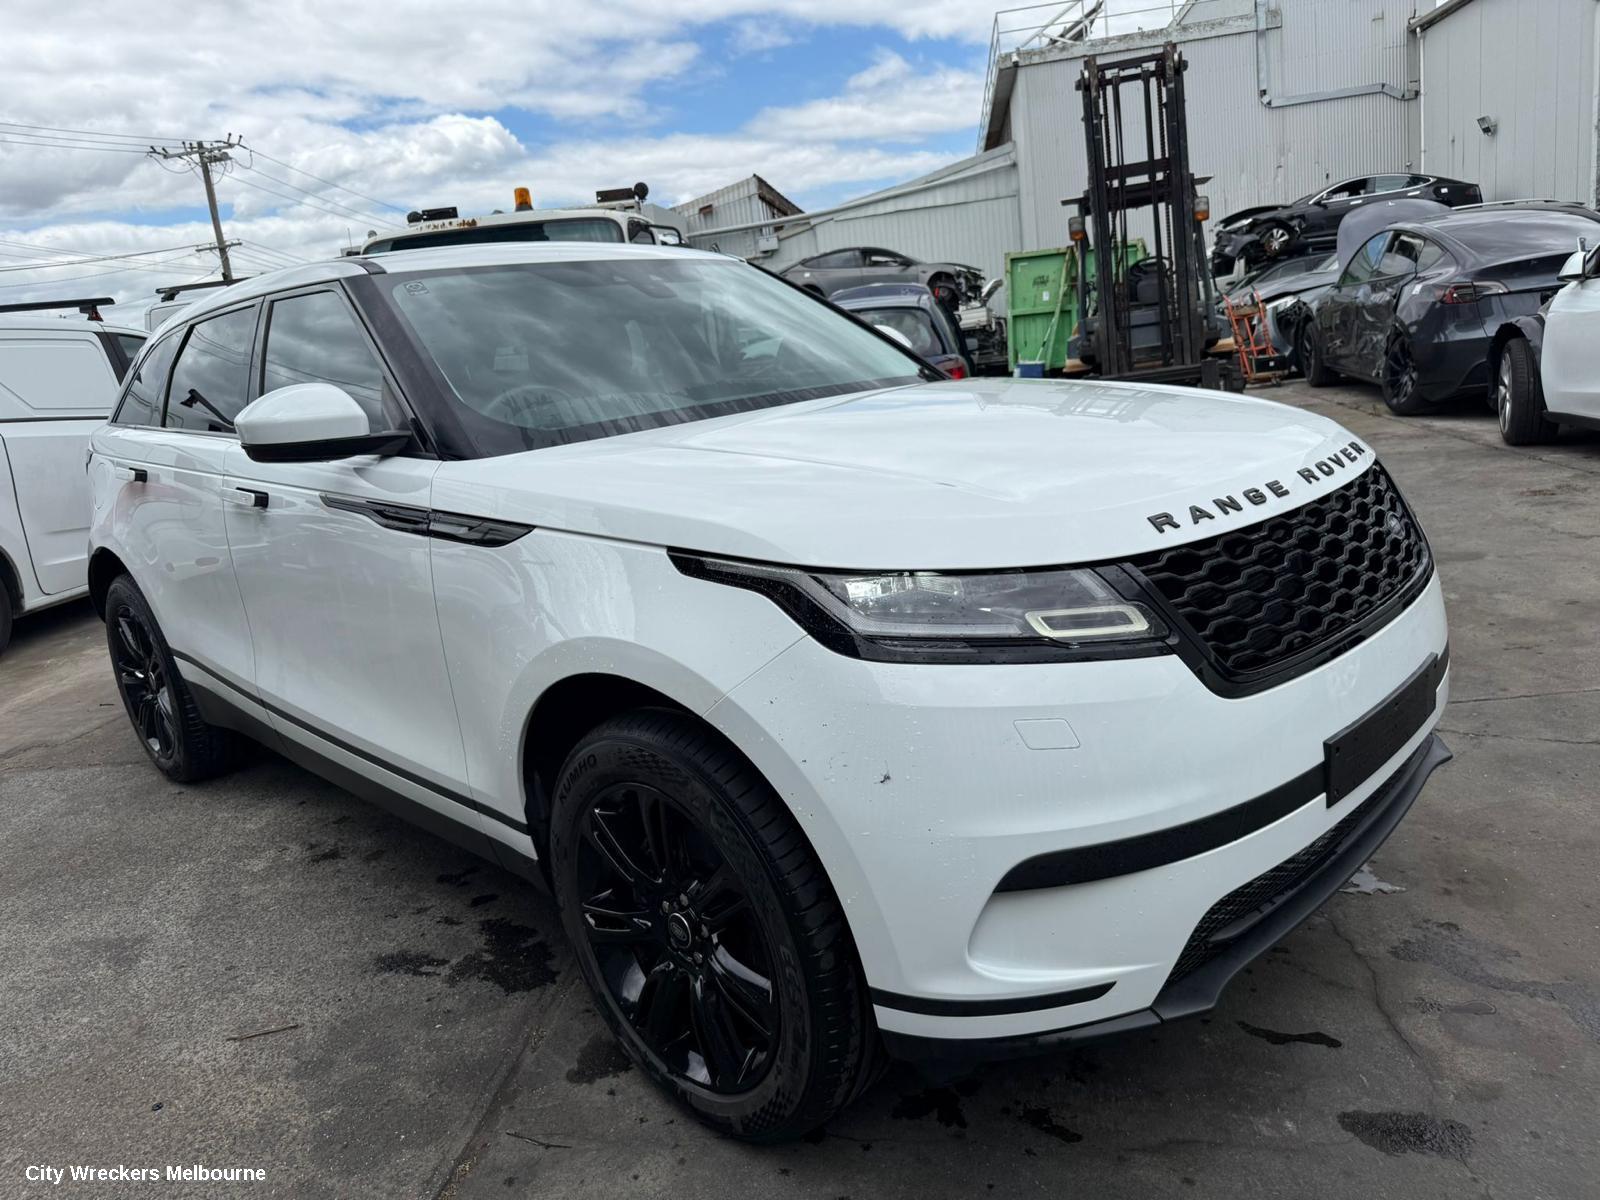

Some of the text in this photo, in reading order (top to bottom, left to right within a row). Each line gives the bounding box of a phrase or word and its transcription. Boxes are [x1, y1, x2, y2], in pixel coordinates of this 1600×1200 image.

[1147, 441, 1366, 533] RANGE ROVER
[559, 754, 597, 806] KUMHO
